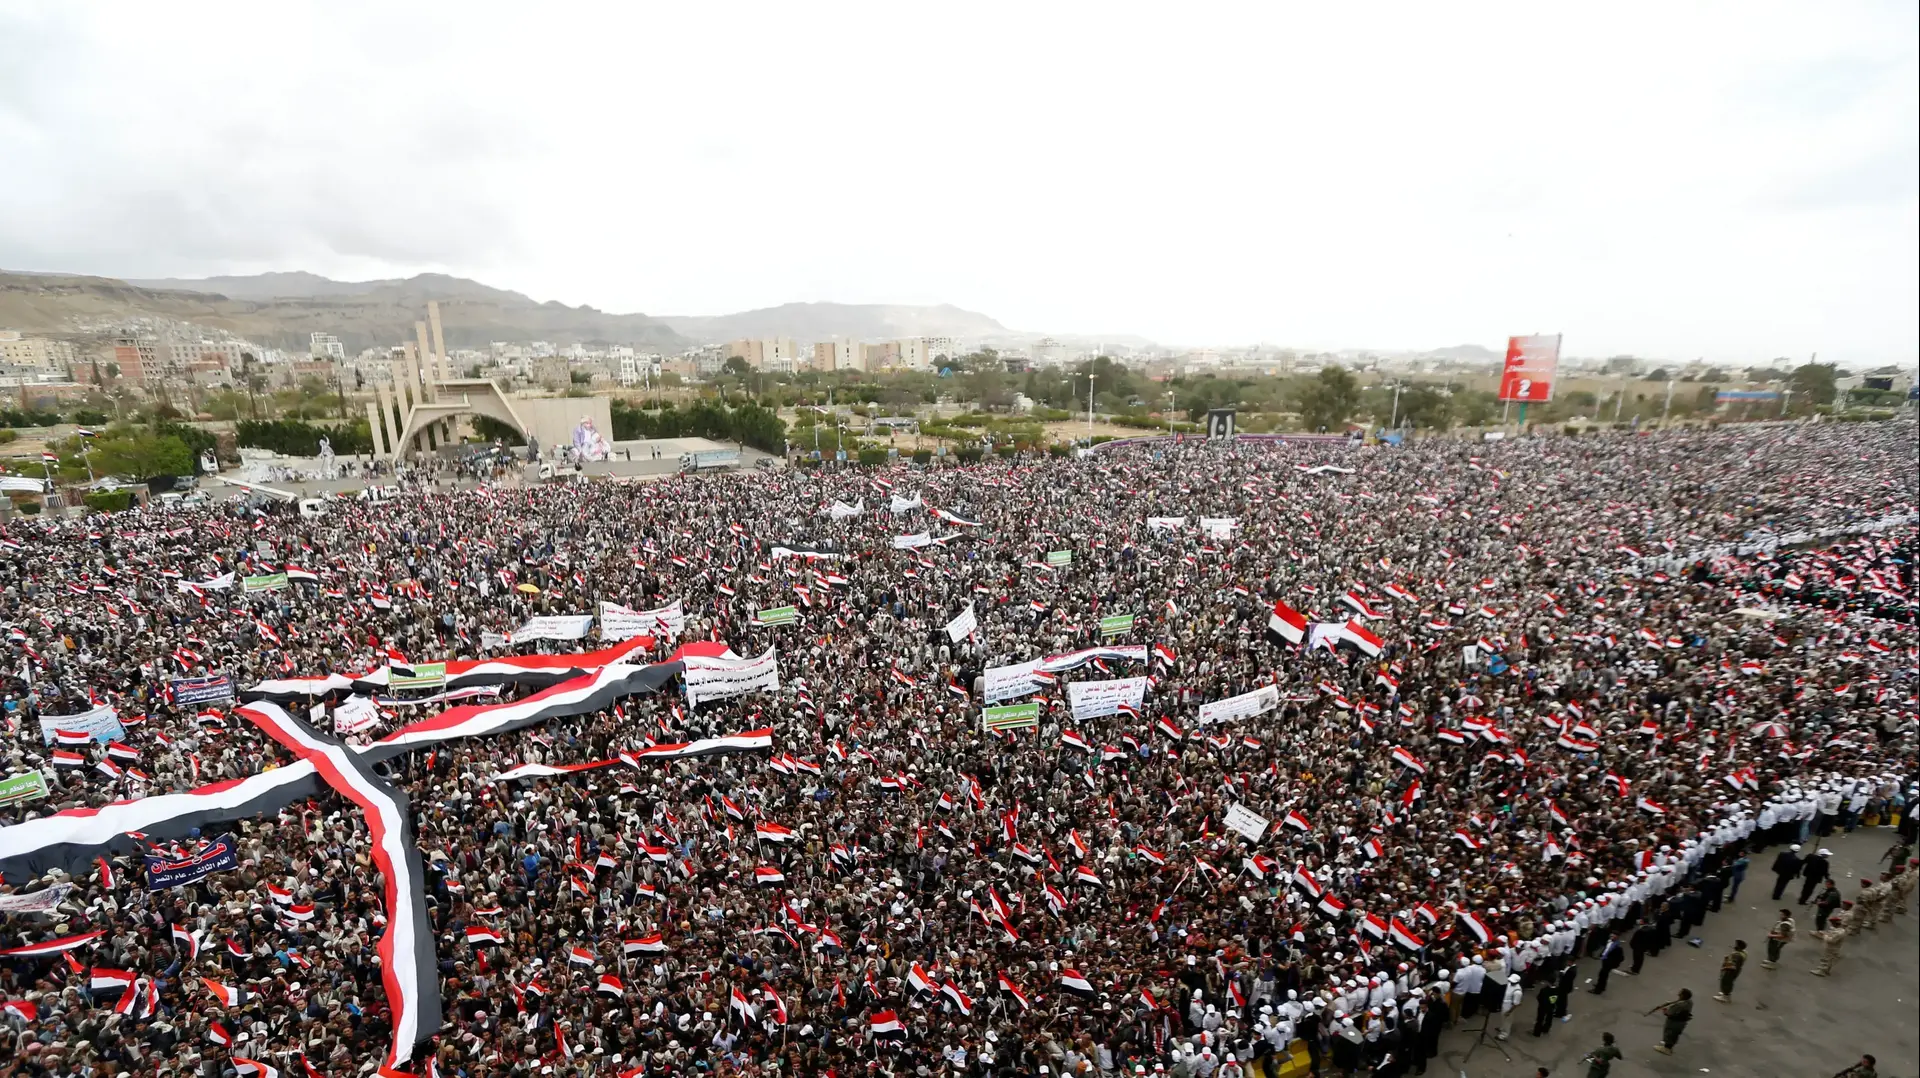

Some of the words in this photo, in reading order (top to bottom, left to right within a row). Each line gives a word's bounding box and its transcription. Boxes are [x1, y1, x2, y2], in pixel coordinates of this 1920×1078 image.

[1517, 379, 1533, 397] 2
[196, 863, 216, 874] الثالث
[216, 856, 231, 869] العام
[154, 874, 173, 884] النصر
